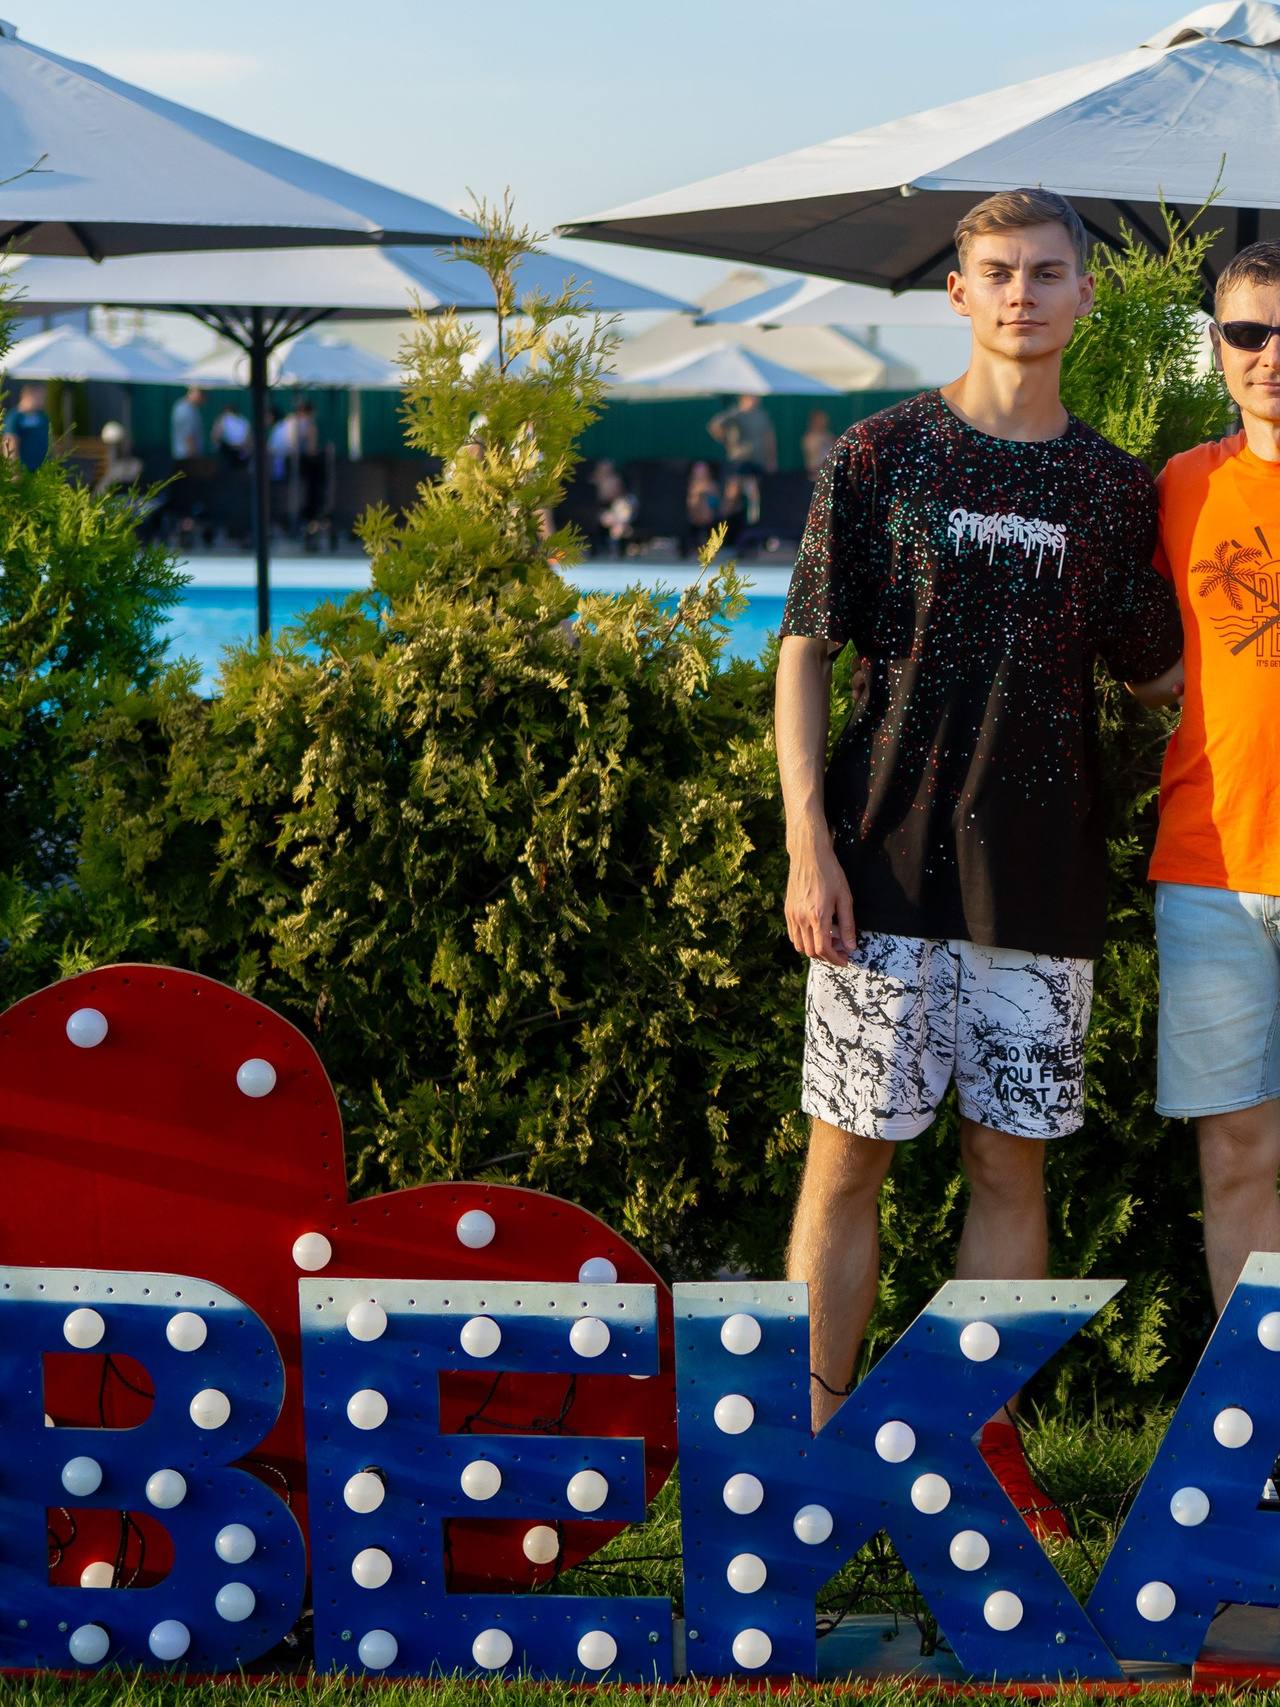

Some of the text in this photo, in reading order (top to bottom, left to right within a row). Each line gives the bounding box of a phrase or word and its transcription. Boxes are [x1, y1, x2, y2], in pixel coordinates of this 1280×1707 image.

[1256, 659, 1269, 667] IT'S
[996, 1042, 1083, 1063] GO WHER
[997, 1064, 1033, 1083] YOU
